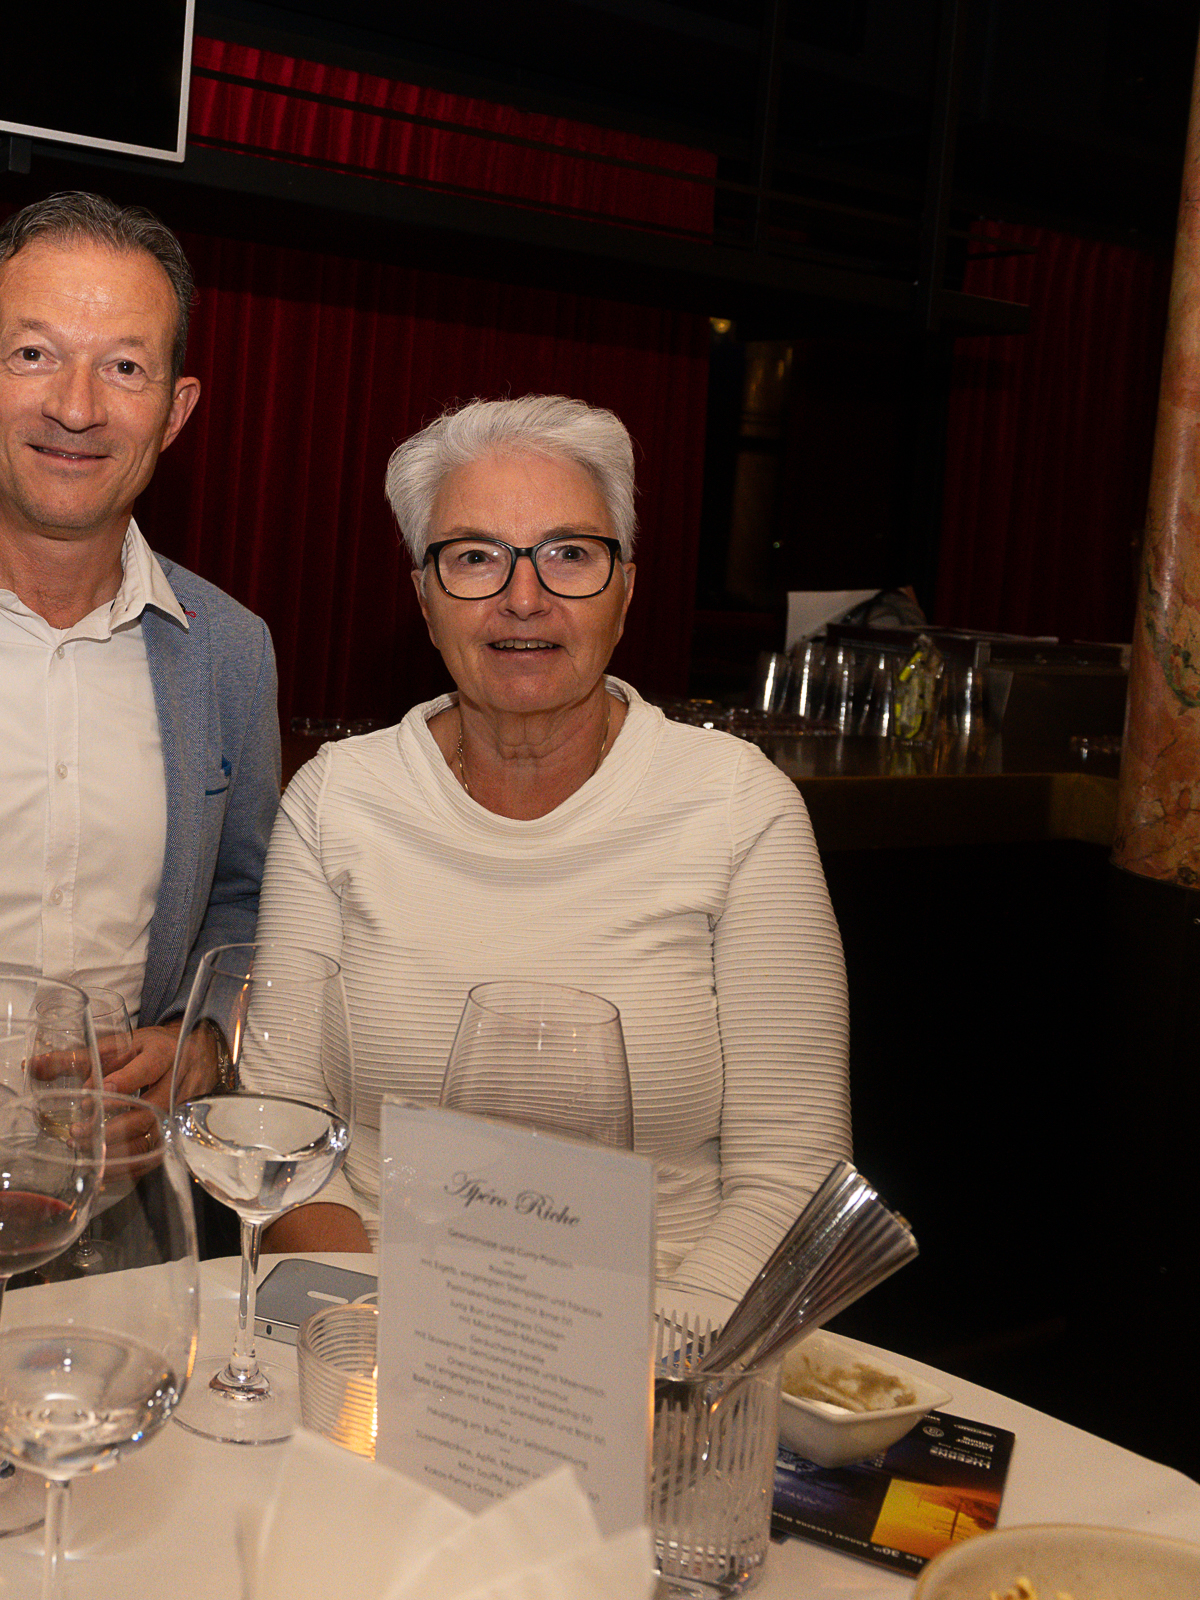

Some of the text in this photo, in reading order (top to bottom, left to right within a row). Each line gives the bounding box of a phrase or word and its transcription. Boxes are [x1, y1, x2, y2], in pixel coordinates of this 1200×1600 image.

[514, 1191, 580, 1225] Riche
[835, 1533, 868, 1548] Annual
[905, 1554, 923, 1564] The
